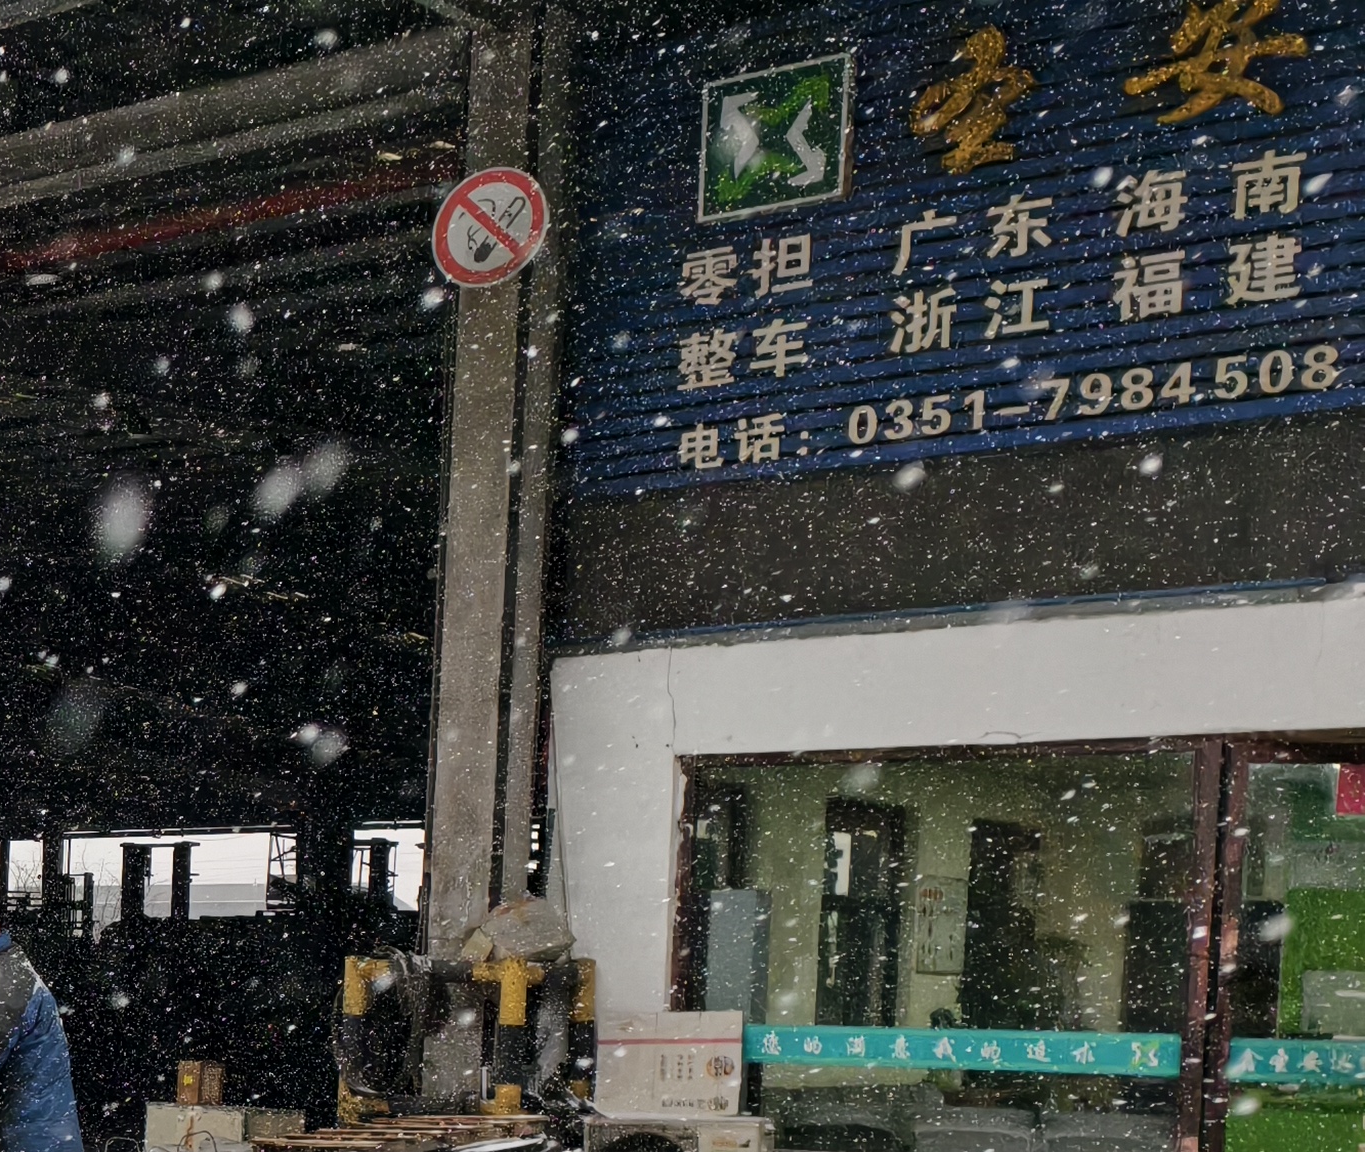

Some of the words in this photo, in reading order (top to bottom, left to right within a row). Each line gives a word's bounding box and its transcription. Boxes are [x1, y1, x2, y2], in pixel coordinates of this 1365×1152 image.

[891, 194, 1053, 275] 广东
[1115, 149, 1308, 238] 海南
[680, 233, 814, 306] 零担
[887, 275, 1052, 354] 浙江
[1113, 235, 1305, 322] 福建
[676, 318, 809, 392] 整车
[847, 344, 1343, 446] 0351-7984508
